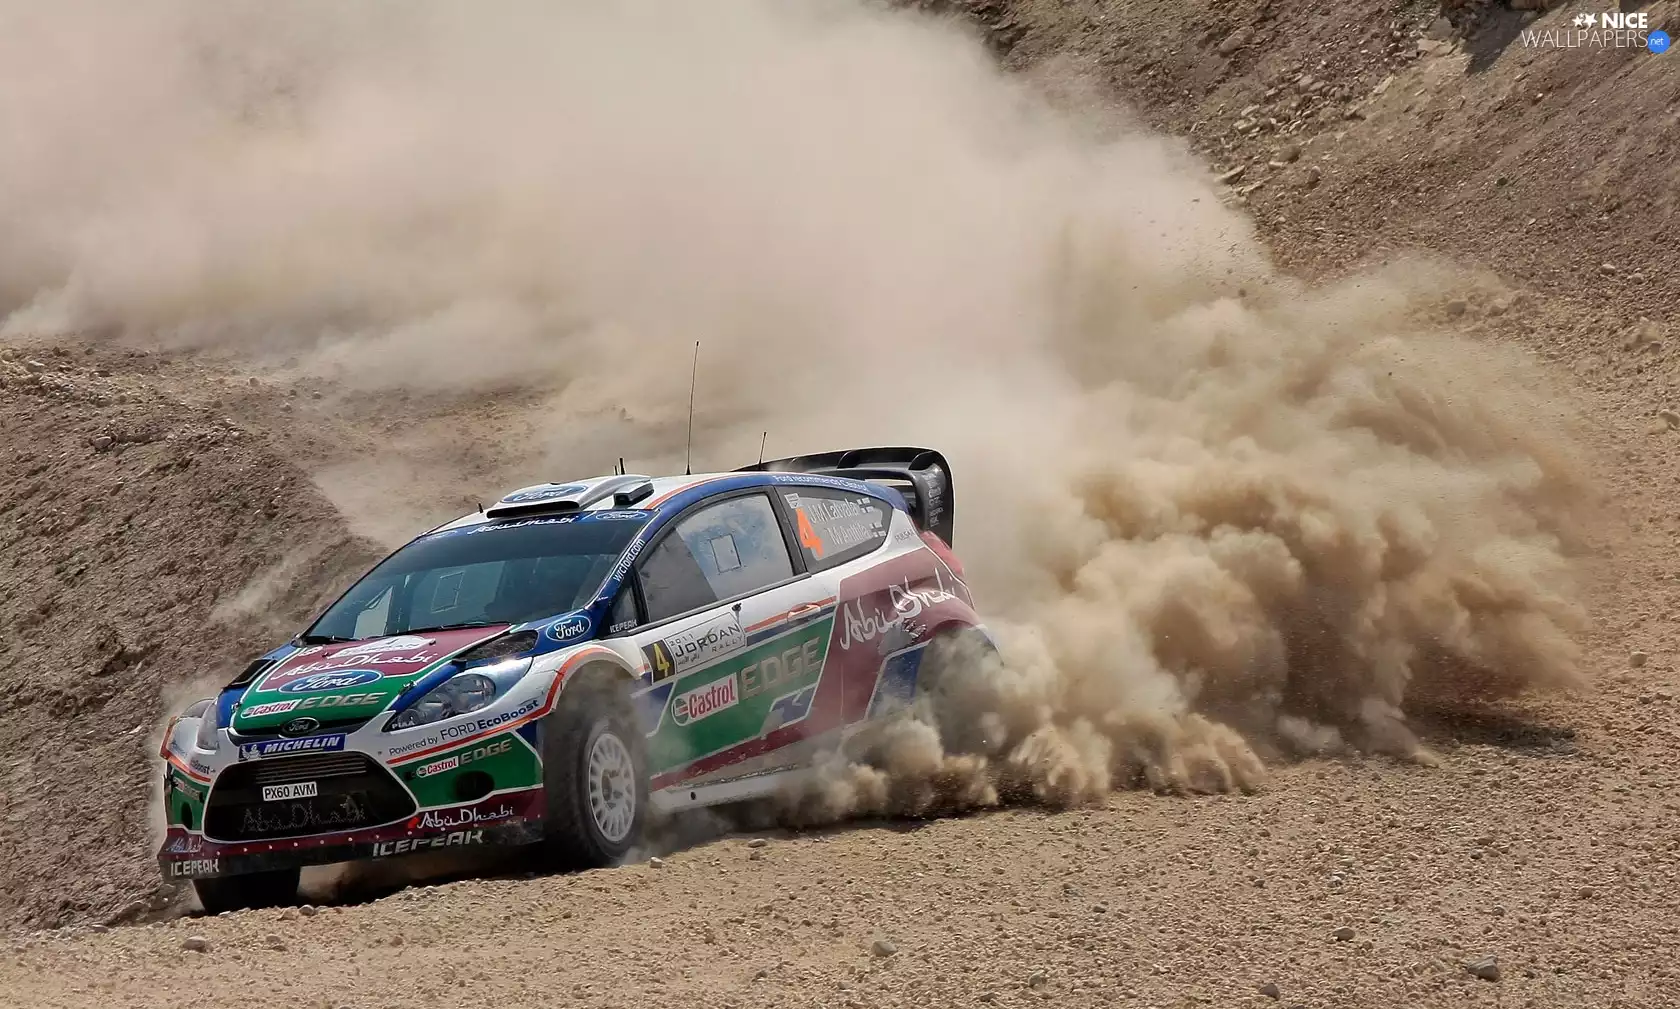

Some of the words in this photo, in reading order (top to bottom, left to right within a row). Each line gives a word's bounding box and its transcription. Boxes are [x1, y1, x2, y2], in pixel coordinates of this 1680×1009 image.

[795, 507, 824, 559] 4
[554, 619, 585, 640] Ford
[609, 619, 638, 633] ICEPEAK
[669, 633, 694, 646] 2011
[675, 624, 741, 657] JORDAN
[711, 636, 743, 653] RALLY
[653, 643, 670, 677] 4
[291, 671, 365, 691] Ford
[688, 677, 736, 719] Castrol
[741, 637, 823, 698] EDGE
[253, 700, 296, 716] Castrol
[298, 692, 388, 710] EDGE
[288, 719, 312, 733] Ford
[389, 738, 427, 756] Powered
[428, 735, 438, 745] by
[440, 722, 476, 741] FORD
[476, 699, 540, 730] EcoBoost
[263, 736, 340, 754] MICHELIN
[427, 757, 457, 775] Castrol
[459, 738, 513, 765] EDGE
[264, 786, 290, 799] PX60
[292, 783, 316, 796] AVM
[372, 829, 484, 858] ICEPEAK
[170, 859, 220, 877] ICEPEAK
